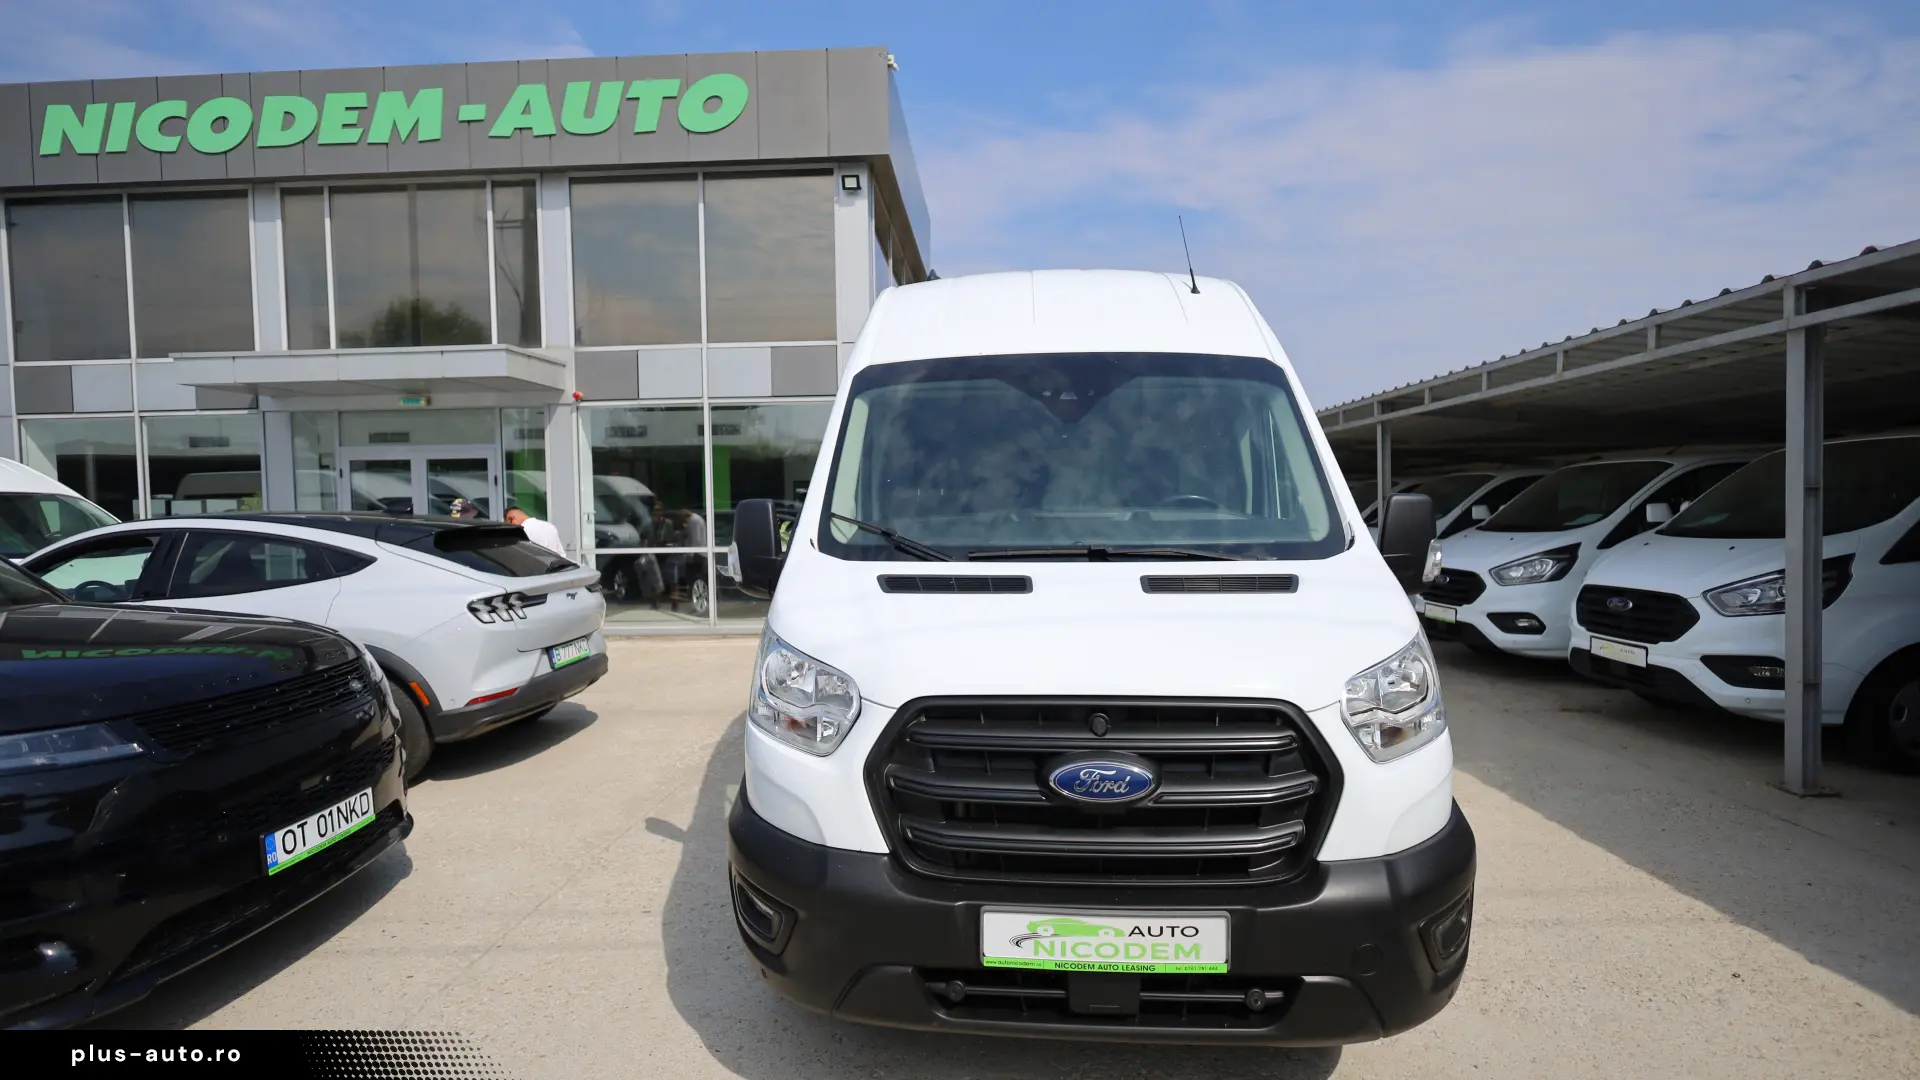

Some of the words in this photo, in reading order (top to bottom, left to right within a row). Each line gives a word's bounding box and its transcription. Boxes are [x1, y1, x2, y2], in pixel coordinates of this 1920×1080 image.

[1073, 768, 1131, 794] Ford
[281, 821, 308, 855] OT
[267, 852, 277, 865] RO
[1128, 926, 1199, 938] AUTO
[1033, 939, 1201, 961] NICODEM
[1054, 962, 1095, 970] NICODEM
[1097, 963, 1119, 972] AUTO
[1121, 964, 1156, 972] LEASING
